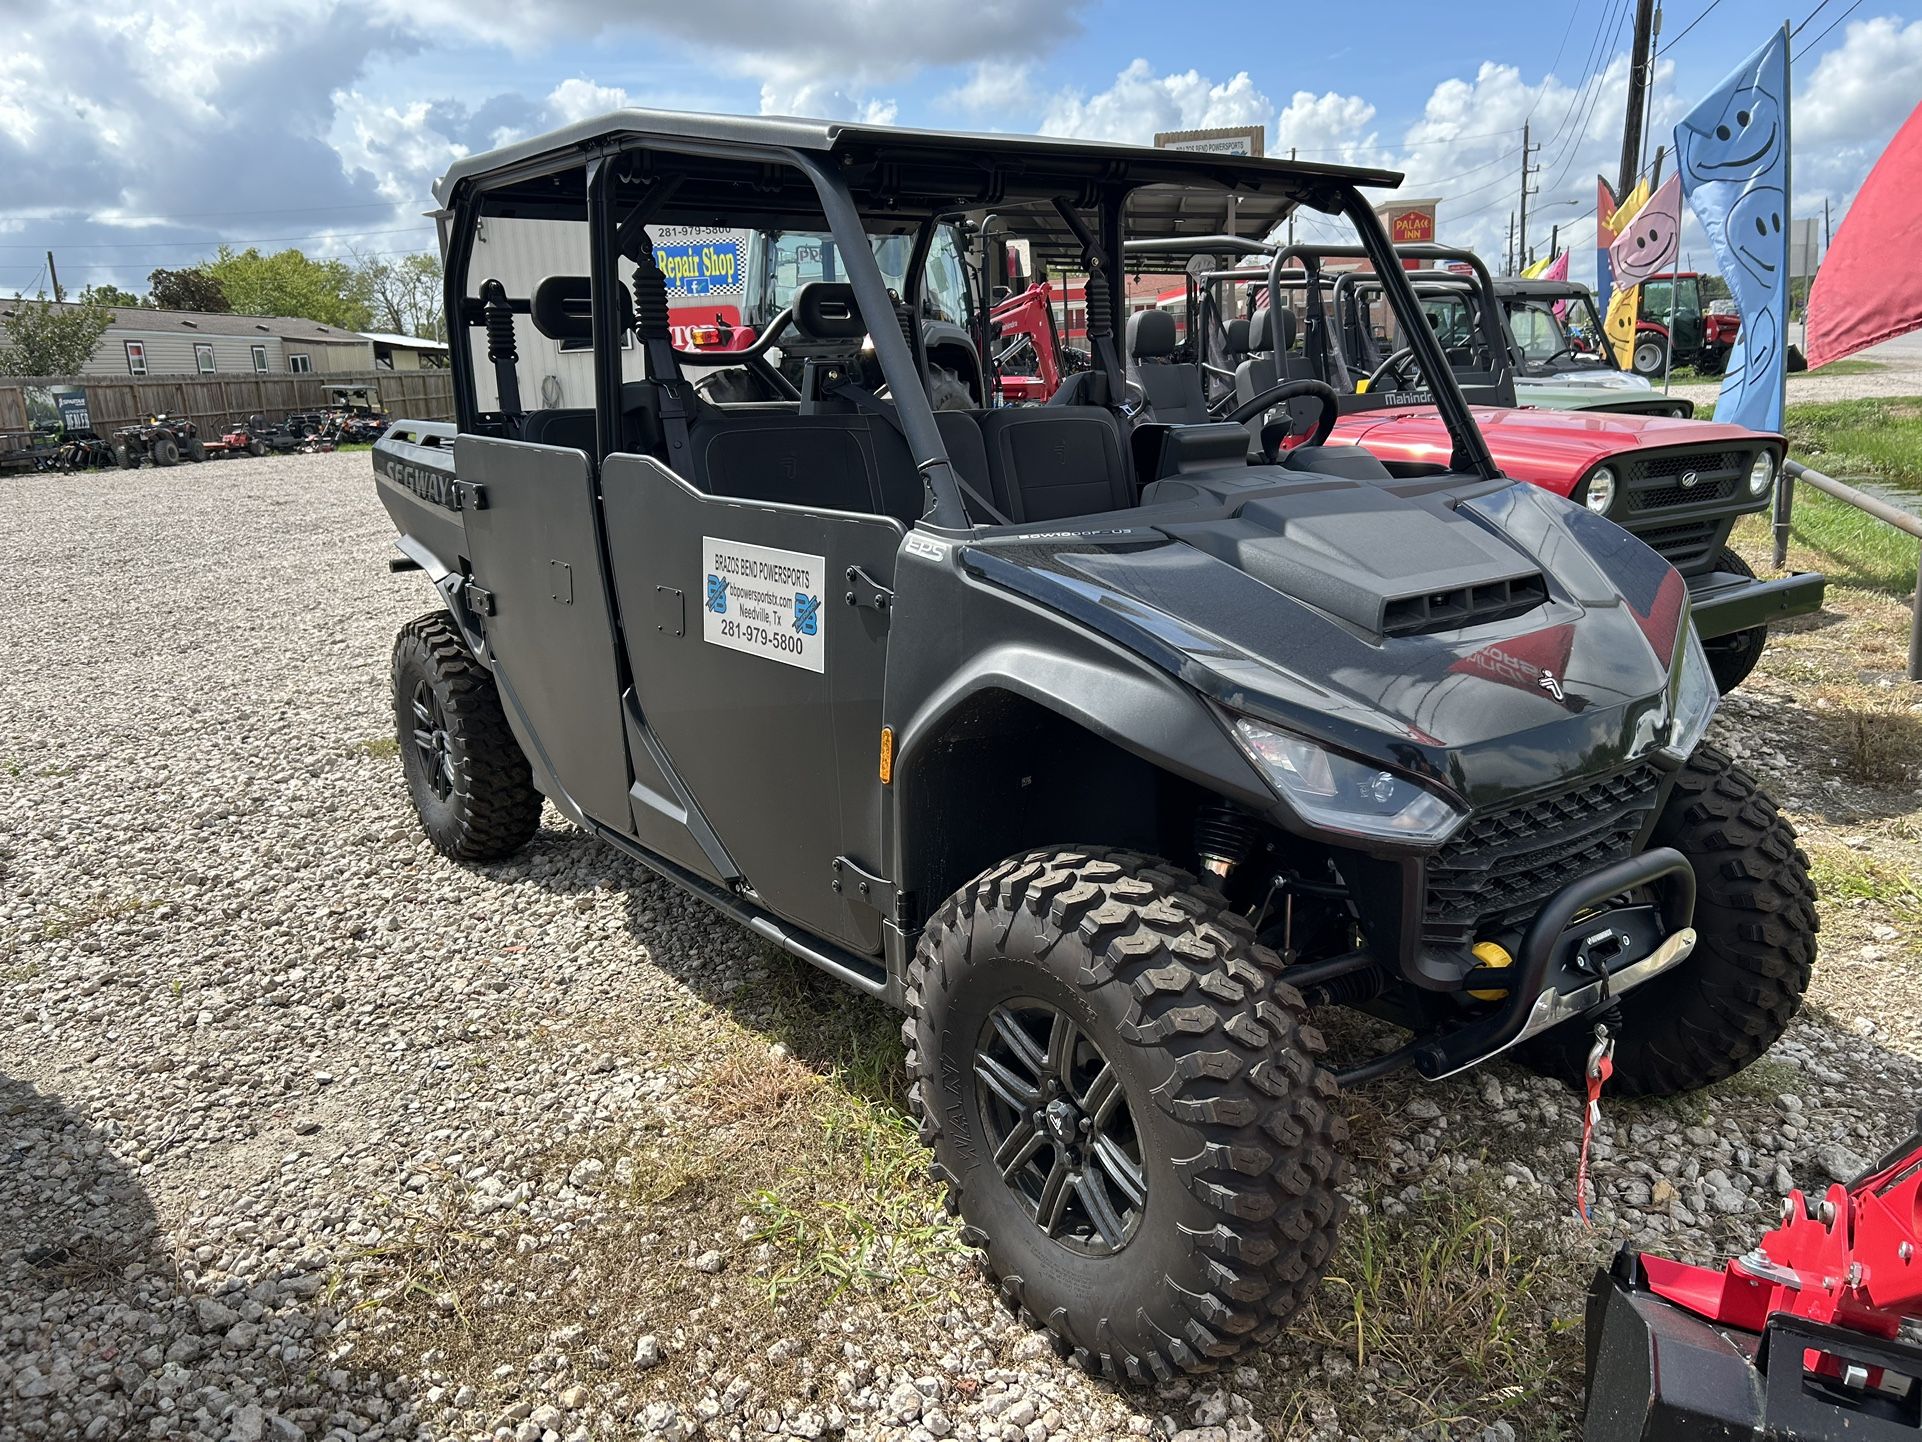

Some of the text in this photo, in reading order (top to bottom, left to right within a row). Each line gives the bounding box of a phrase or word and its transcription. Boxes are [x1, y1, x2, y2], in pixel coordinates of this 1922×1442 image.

[1209, 141, 1244, 152] POWERSPORTS
[1396, 219, 1429, 230] PALACE
[1404, 230, 1421, 239] INN
[657, 246, 735, 286] Repair Shop
[1385, 392, 1435, 405] Mahindr
[386, 461, 449, 504] SEGWAY
[905, 536, 947, 561] EPS
[715, 553, 810, 589] BRAZOS BEND POWERSPORTS
[729, 582, 793, 609] bbpowersportstx.com
[739, 603, 782, 626] Needville, Tx
[721, 618, 803, 655] 281-979-5800
